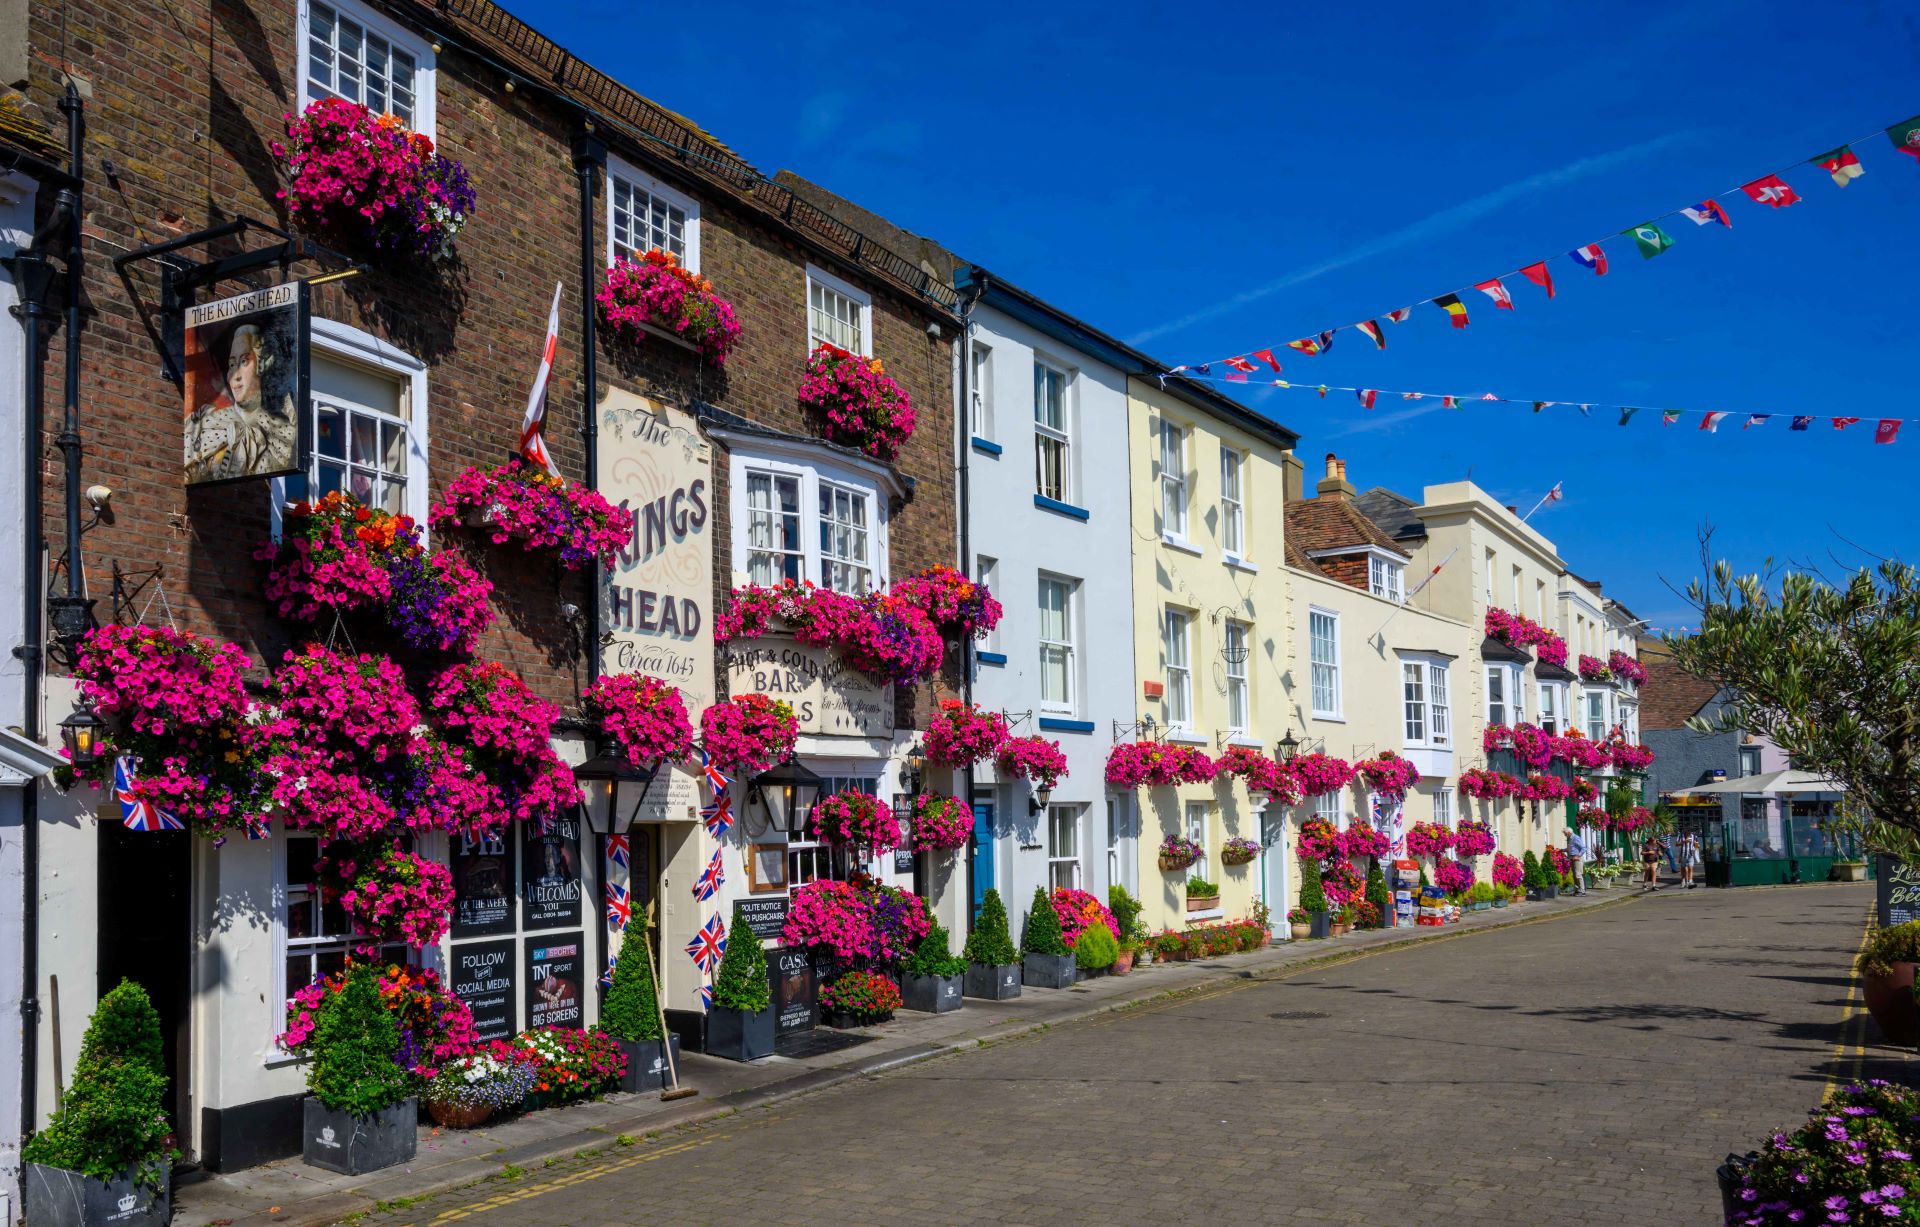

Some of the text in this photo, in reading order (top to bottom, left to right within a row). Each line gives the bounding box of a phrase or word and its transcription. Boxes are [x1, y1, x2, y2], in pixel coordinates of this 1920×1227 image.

[192, 286, 292, 324] THE KING'S HEAD
[632, 408, 671, 447] The
[611, 584, 702, 642] HEAD
[618, 642, 663, 673] Circa
[735, 649, 818, 679] HOT & COLD
[755, 669, 799, 693] BAR
[895, 849, 913, 861] APEROL
[527, 879, 580, 903] WELCOMES
[472, 898, 485, 909] THE
[486, 897, 508, 908] WEEK
[543, 902, 559, 911] YOU
[741, 902, 782, 912] POLITE NOTICE
[751, 911, 785, 922] PUSHCHAIRS
[462, 952, 506, 969] FOLLOW
[533, 947, 575, 959] SKY SPORTS
[779, 952, 809, 971] CASK
[532, 963, 573, 981] TNT SPORT
[456, 980, 485, 995] SOCIAL
[486, 978, 511, 992] MEDIA
[532, 1006, 579, 1027] BIG SCREENS
